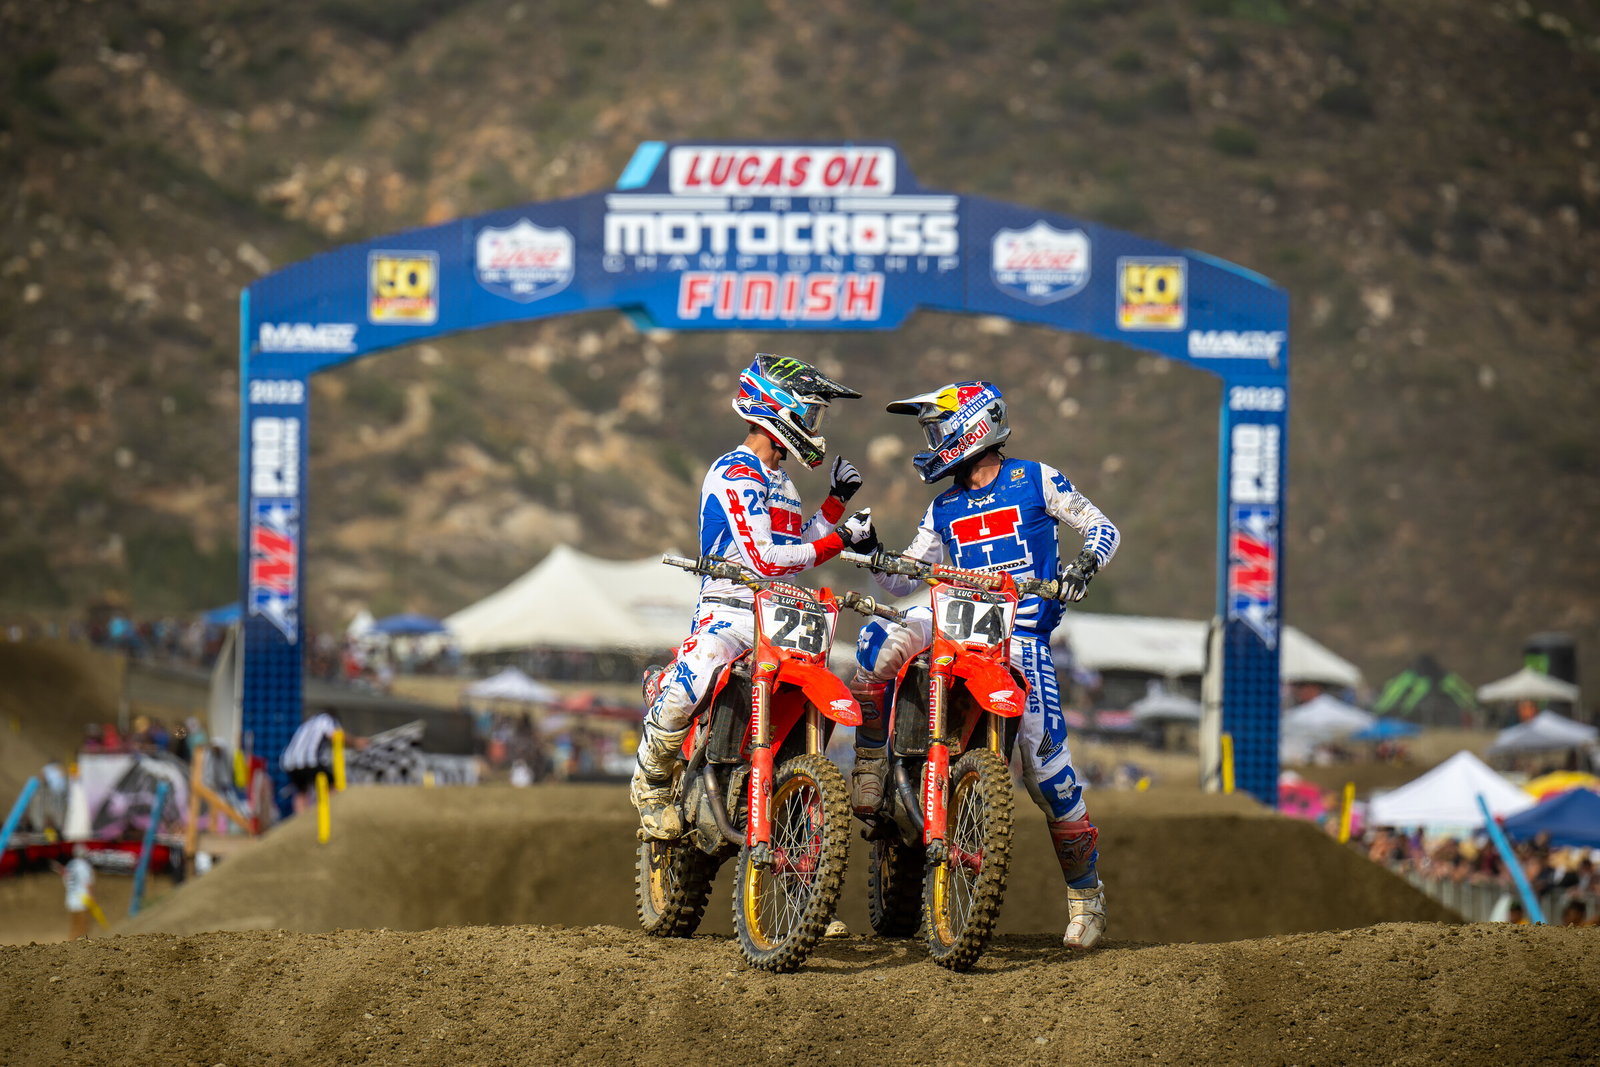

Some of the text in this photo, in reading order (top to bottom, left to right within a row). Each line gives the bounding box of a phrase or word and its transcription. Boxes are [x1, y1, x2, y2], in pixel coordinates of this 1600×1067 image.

[684, 155, 881, 187] LUCAS OIL
[603, 213, 960, 255] MOTOCROSS
[602, 256, 960, 273] CHAMPIONSHIP
[678, 271, 886, 320] FINISH
[938, 419, 991, 464] Red Bull
[988, 560, 1027, 572] HONDA
[770, 607, 825, 654] 23
[943, 600, 1004, 645] 94
[1041, 742, 1063, 762] HONDA
[751, 767, 760, 828] DUNLOP
[926, 761, 936, 821] DUNLOP
